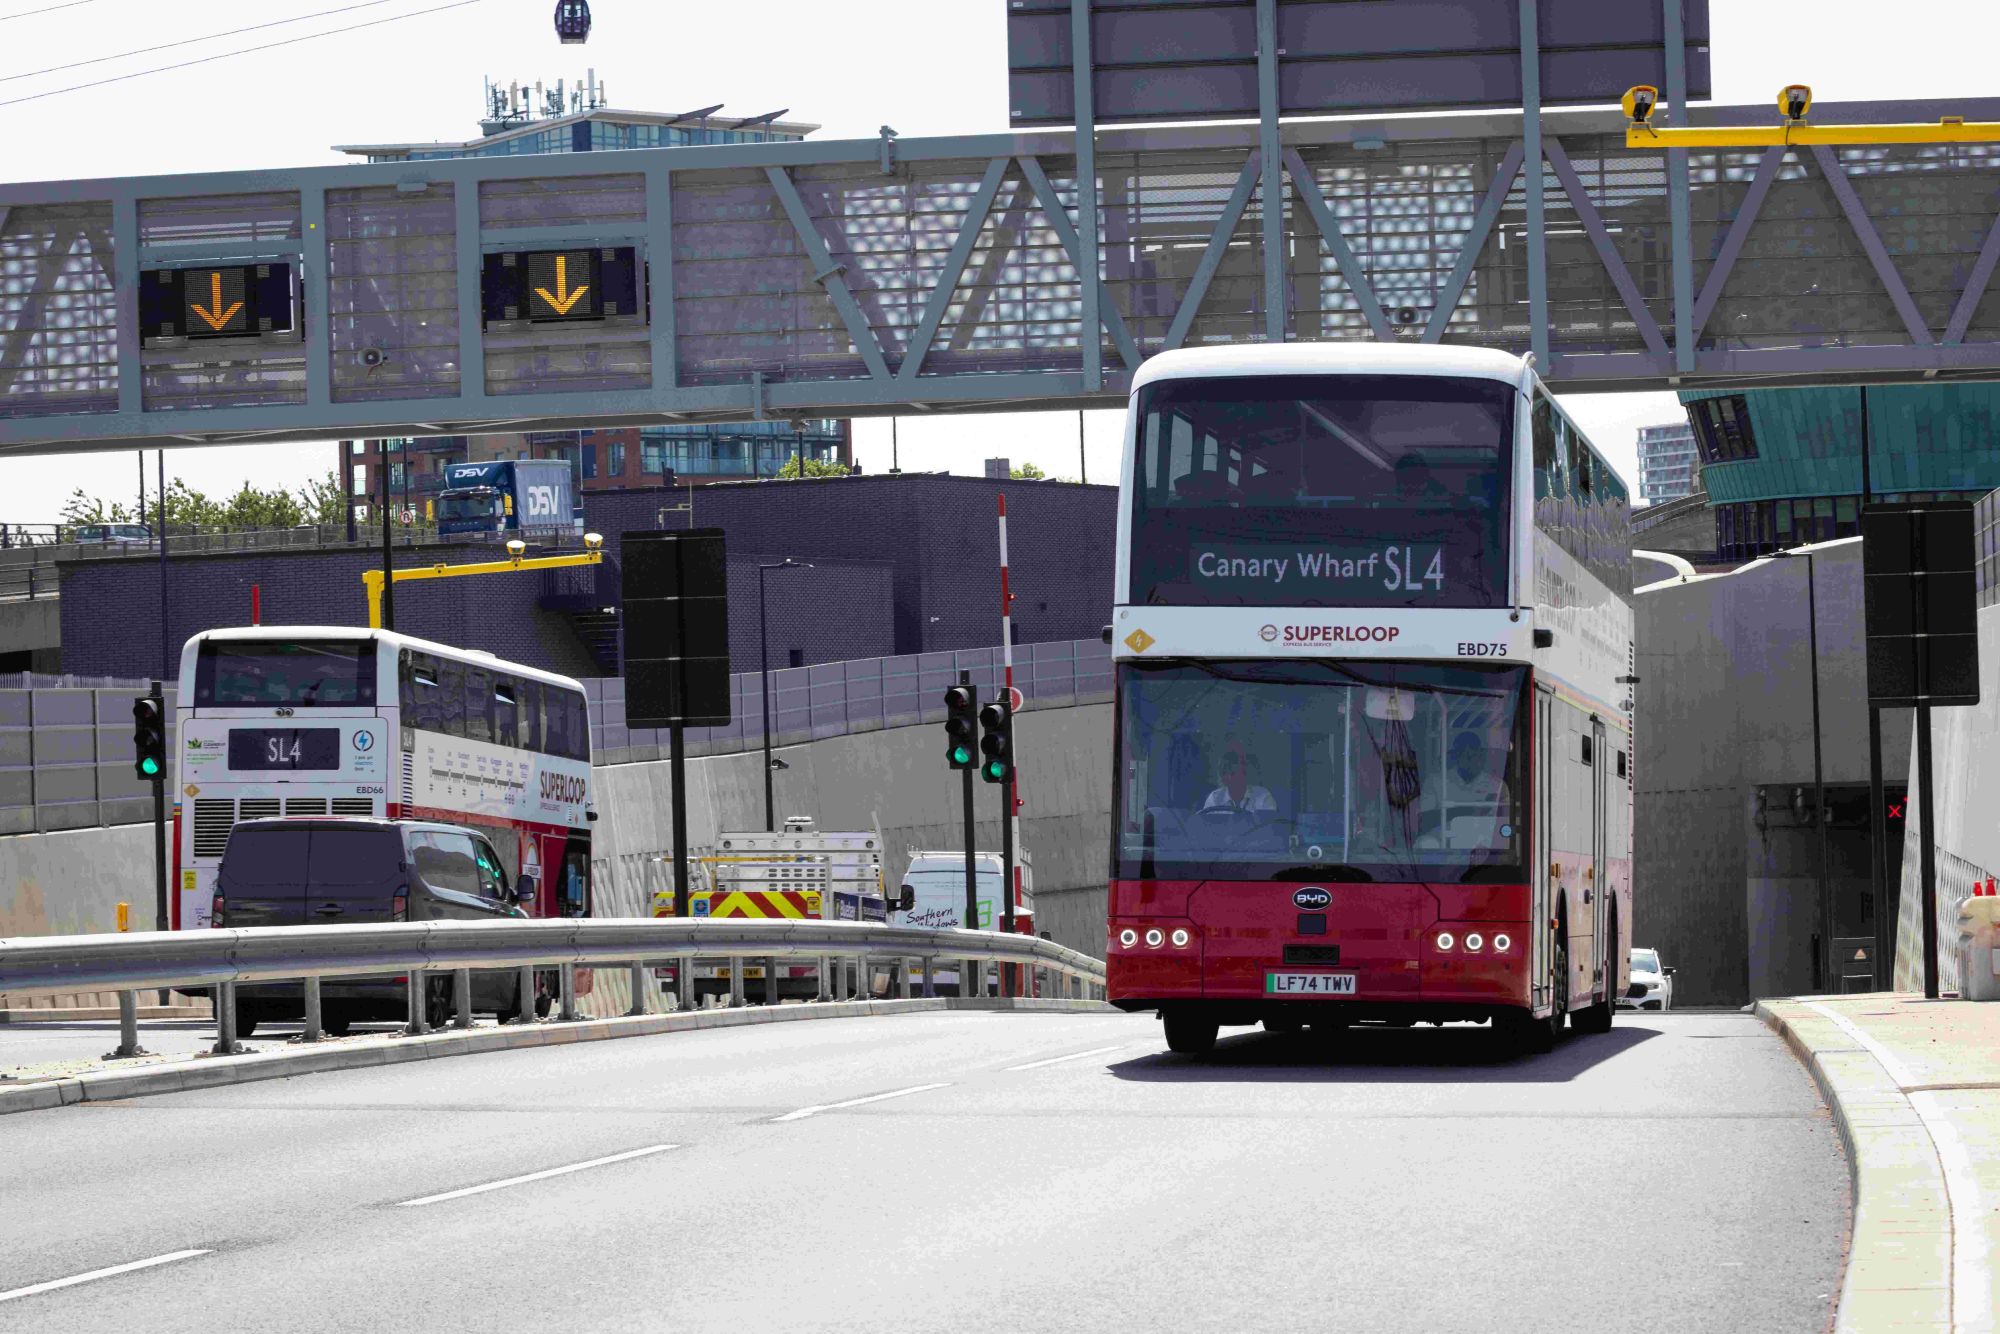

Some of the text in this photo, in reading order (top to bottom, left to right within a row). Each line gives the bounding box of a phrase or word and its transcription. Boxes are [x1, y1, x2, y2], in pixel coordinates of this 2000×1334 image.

[454, 467, 489, 479] DSV
[527, 485, 559, 516] DSV
[1197, 545, 1445, 591] Canary Wharf SL4
[1283, 625, 1400, 642] SUPERLOOP
[1457, 642, 1508, 656] EBD75
[268, 737, 302, 762] SL4
[356, 786, 384, 794] EBD66
[540, 770, 586, 805] SUPERLOOP
[1296, 894, 1328, 903] BYD
[906, 907, 953, 924] Southern
[1277, 976, 1353, 991] LF74 TWV
